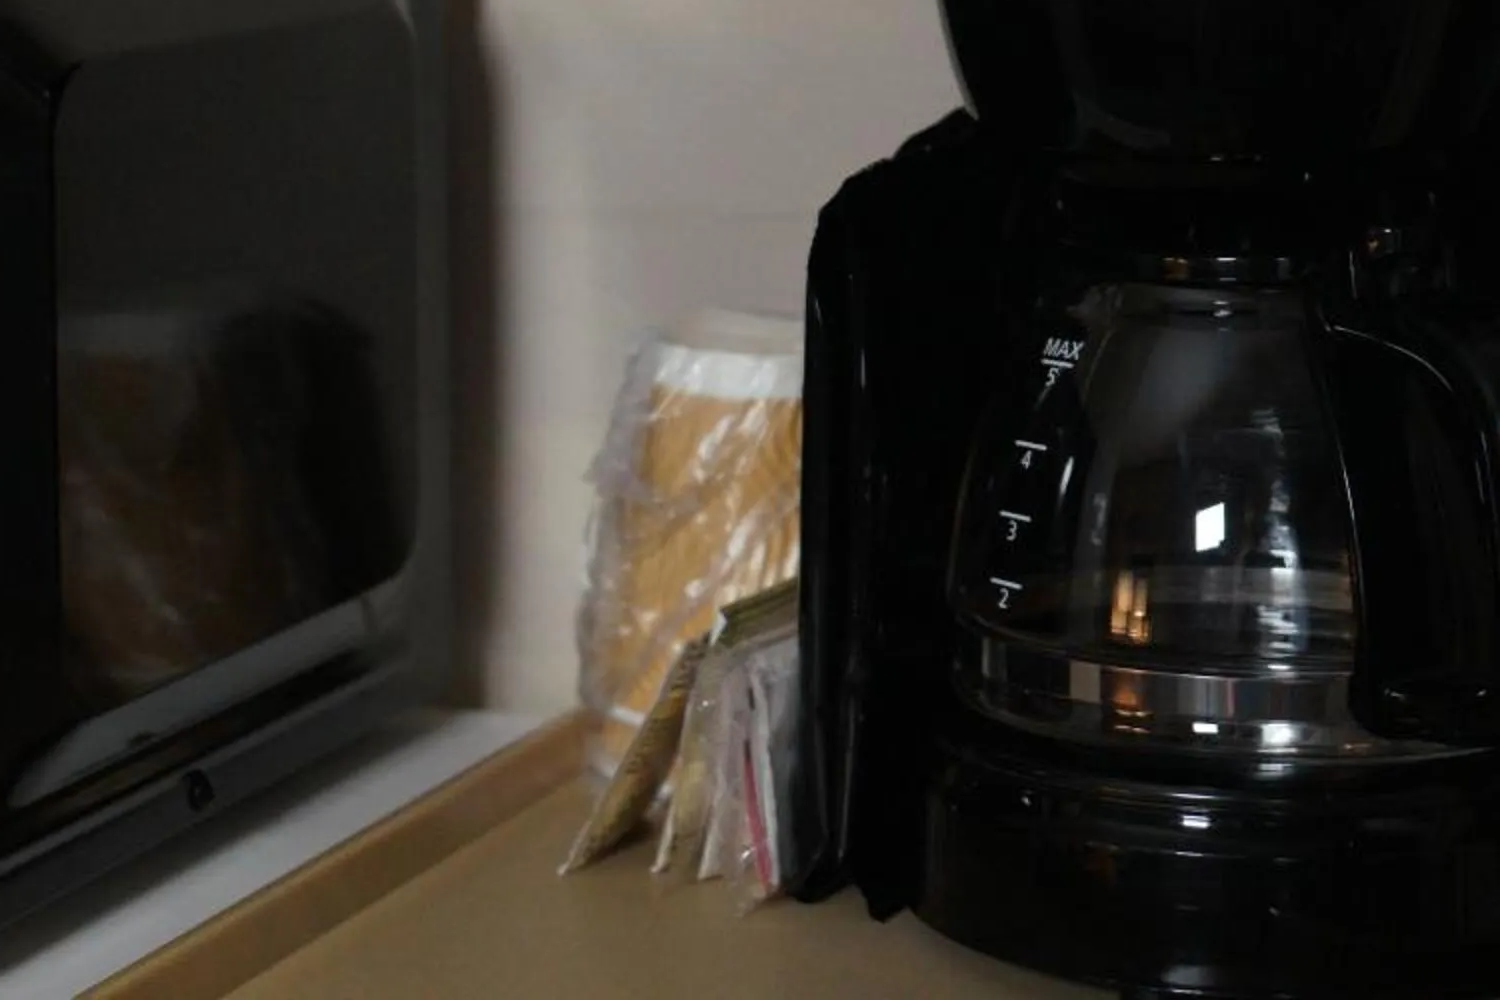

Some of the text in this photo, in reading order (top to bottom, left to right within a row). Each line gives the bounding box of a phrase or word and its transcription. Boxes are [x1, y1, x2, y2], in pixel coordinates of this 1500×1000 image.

[1044, 337, 1084, 360] MAX
[1045, 368, 1059, 387] 5
[1021, 451, 1032, 469] 4
[1006, 522, 1017, 541] 3
[998, 588, 1010, 609] 2
